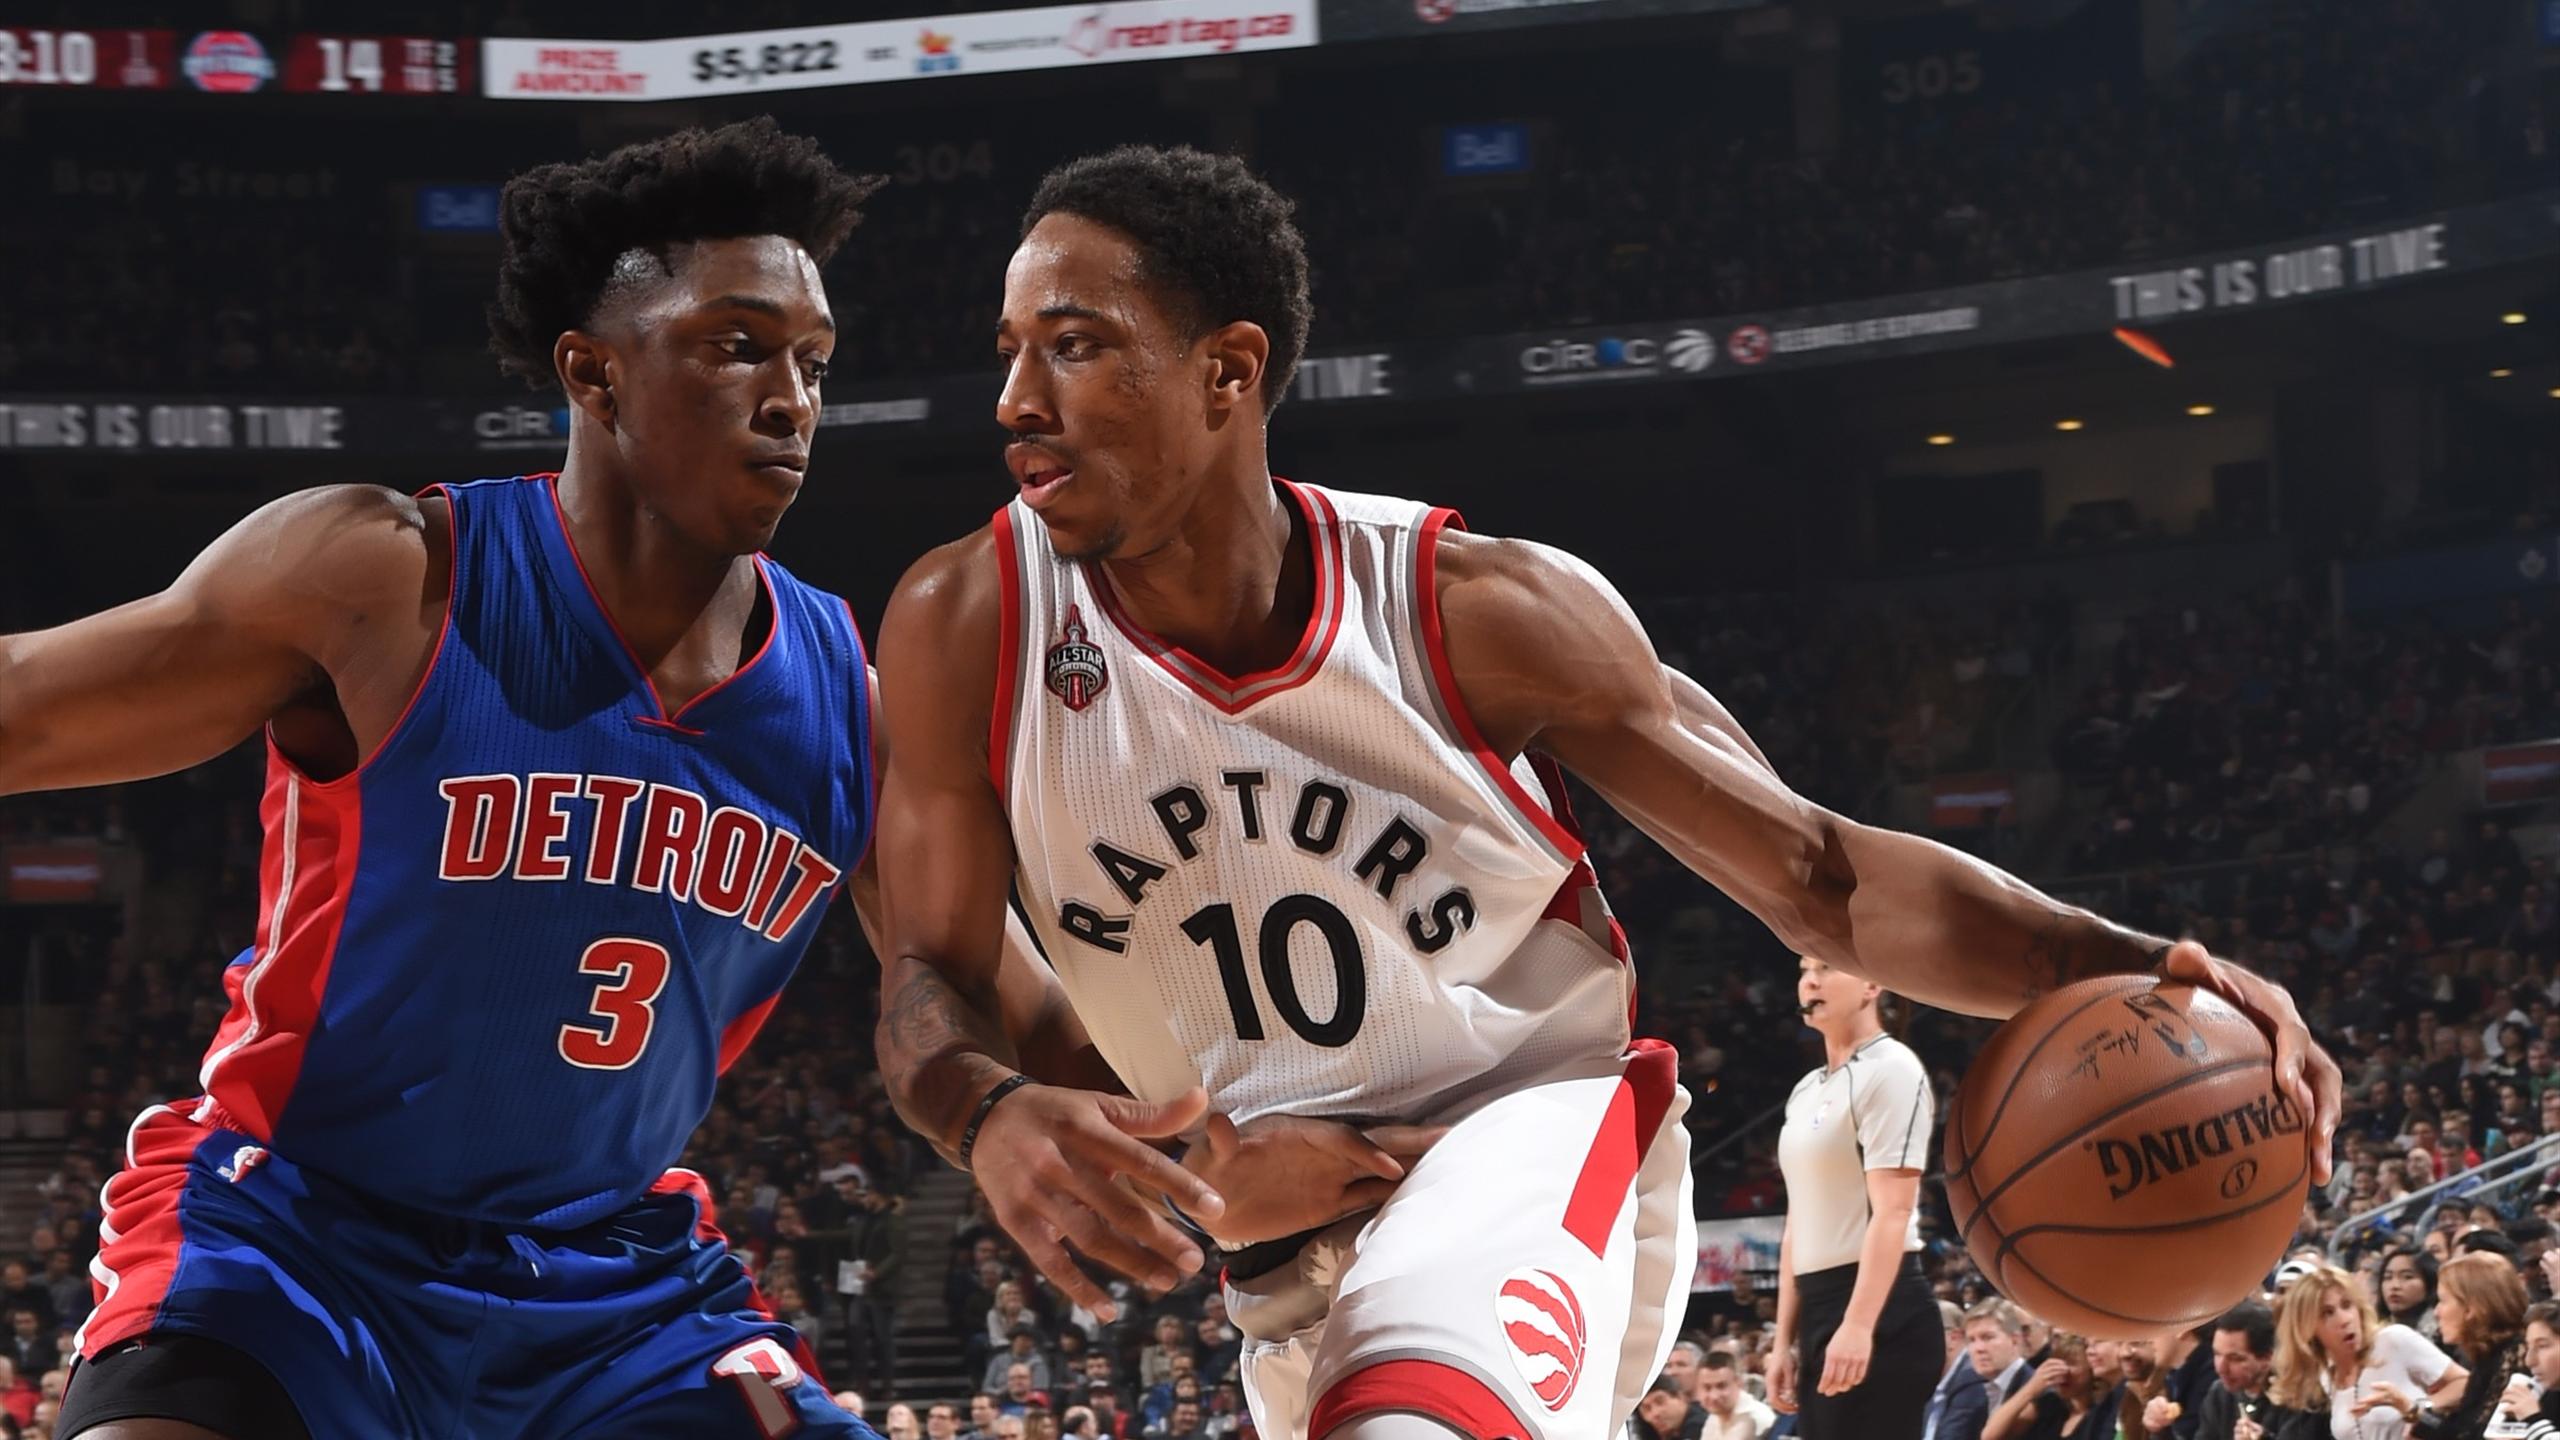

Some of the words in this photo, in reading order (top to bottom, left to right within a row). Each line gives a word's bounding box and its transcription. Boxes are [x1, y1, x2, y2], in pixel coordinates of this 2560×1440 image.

[318, 39, 383, 91] 14
[514, 73, 646, 94] AMOUNT
[537, 48, 621, 71] PRIZE
[692, 40, 840, 83] $5,822
[1882, 50, 1983, 103] 305
[895, 140, 993, 186] 304
[1454, 132, 1519, 168] Bell
[2110, 266, 2206, 320] THIS
[2212, 259, 2258, 306] IS
[2265, 244, 2344, 299] OUR
[2349, 222, 2448, 284] TIME
[95, 404, 140, 448] IS
[149, 404, 234, 448] OUR
[239, 405, 344, 448] TIME
[438, 773, 842, 943] DETROIT
[1059, 766, 1480, 957] RAPTORS
[1179, 893, 1367, 1048] 10
[557, 937, 671, 1070] 3
[2097, 1093, 2304, 1200] PALDING
